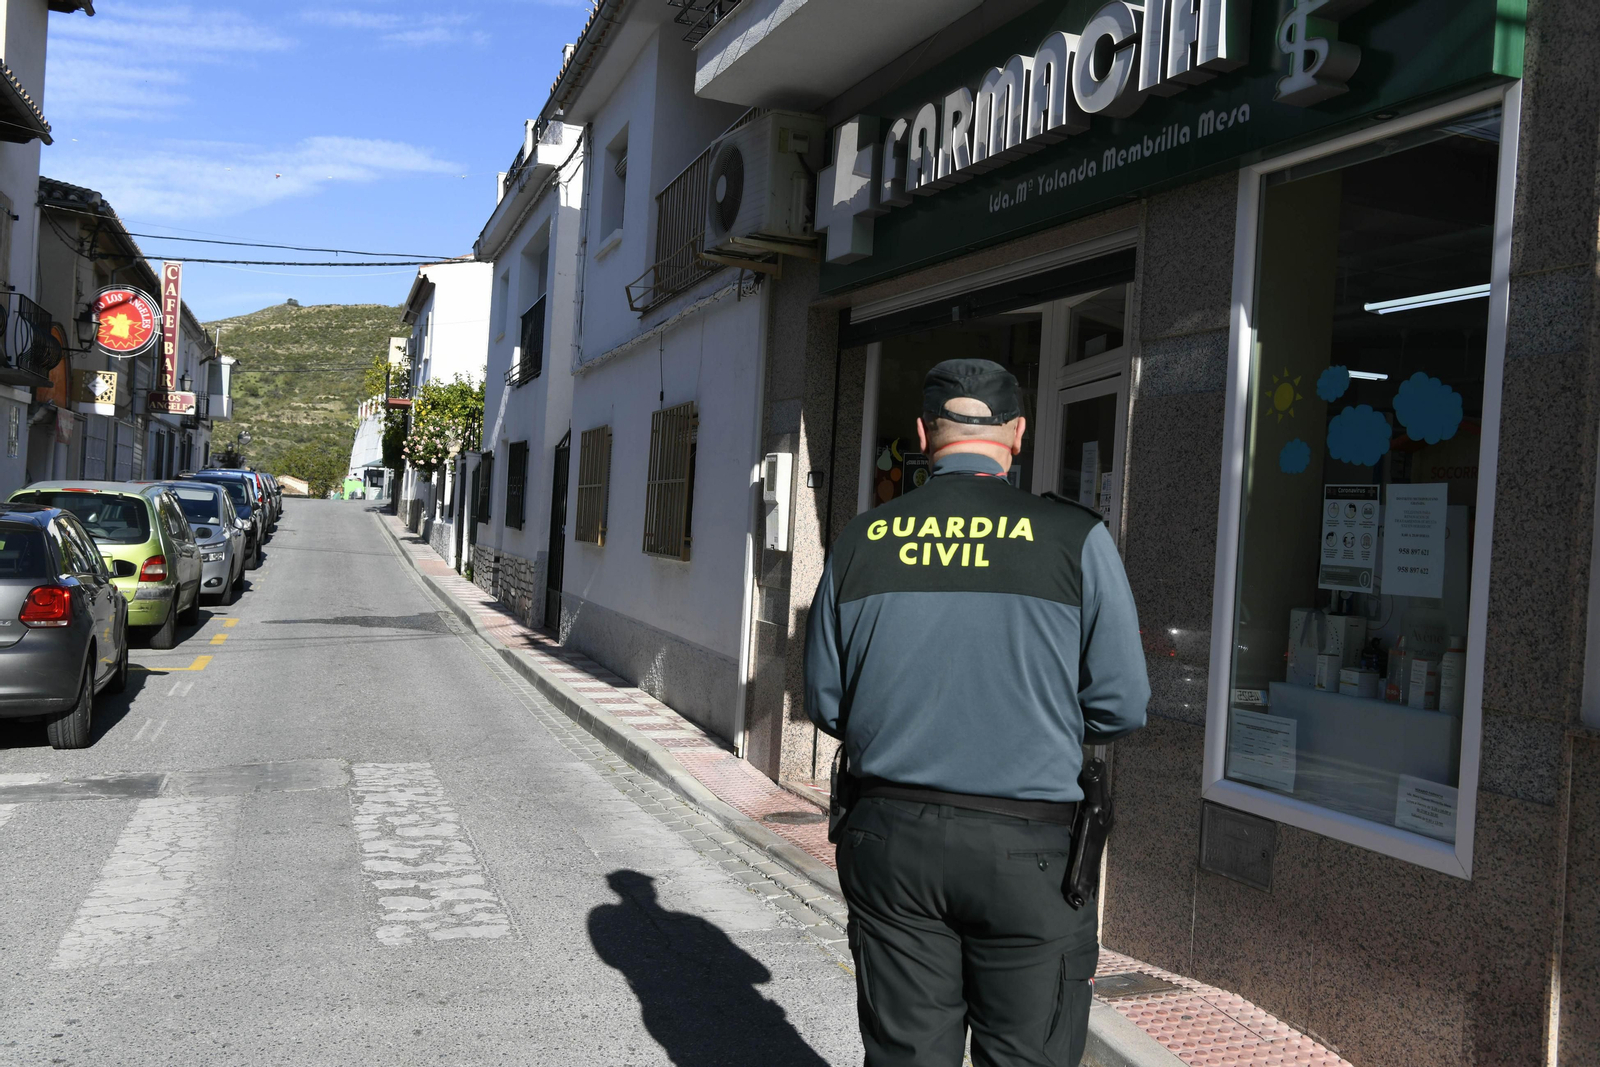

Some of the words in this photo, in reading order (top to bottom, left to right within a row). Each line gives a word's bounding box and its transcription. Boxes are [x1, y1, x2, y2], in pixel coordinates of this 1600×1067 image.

[880, 0, 1230, 206] FARMACIA
[1037, 158, 1097, 197] Yolanda
[1101, 123, 1191, 173] Membrilla
[1197, 103, 1251, 139] Mesa
[105, 293, 123, 304] LOS
[127, 296, 151, 329] ANGELES
[162, 394, 181, 402] LOS
[867, 516, 1034, 542] GUARDIA
[899, 542, 990, 567] CIVIL
[1410, 566, 1420, 574] 897
